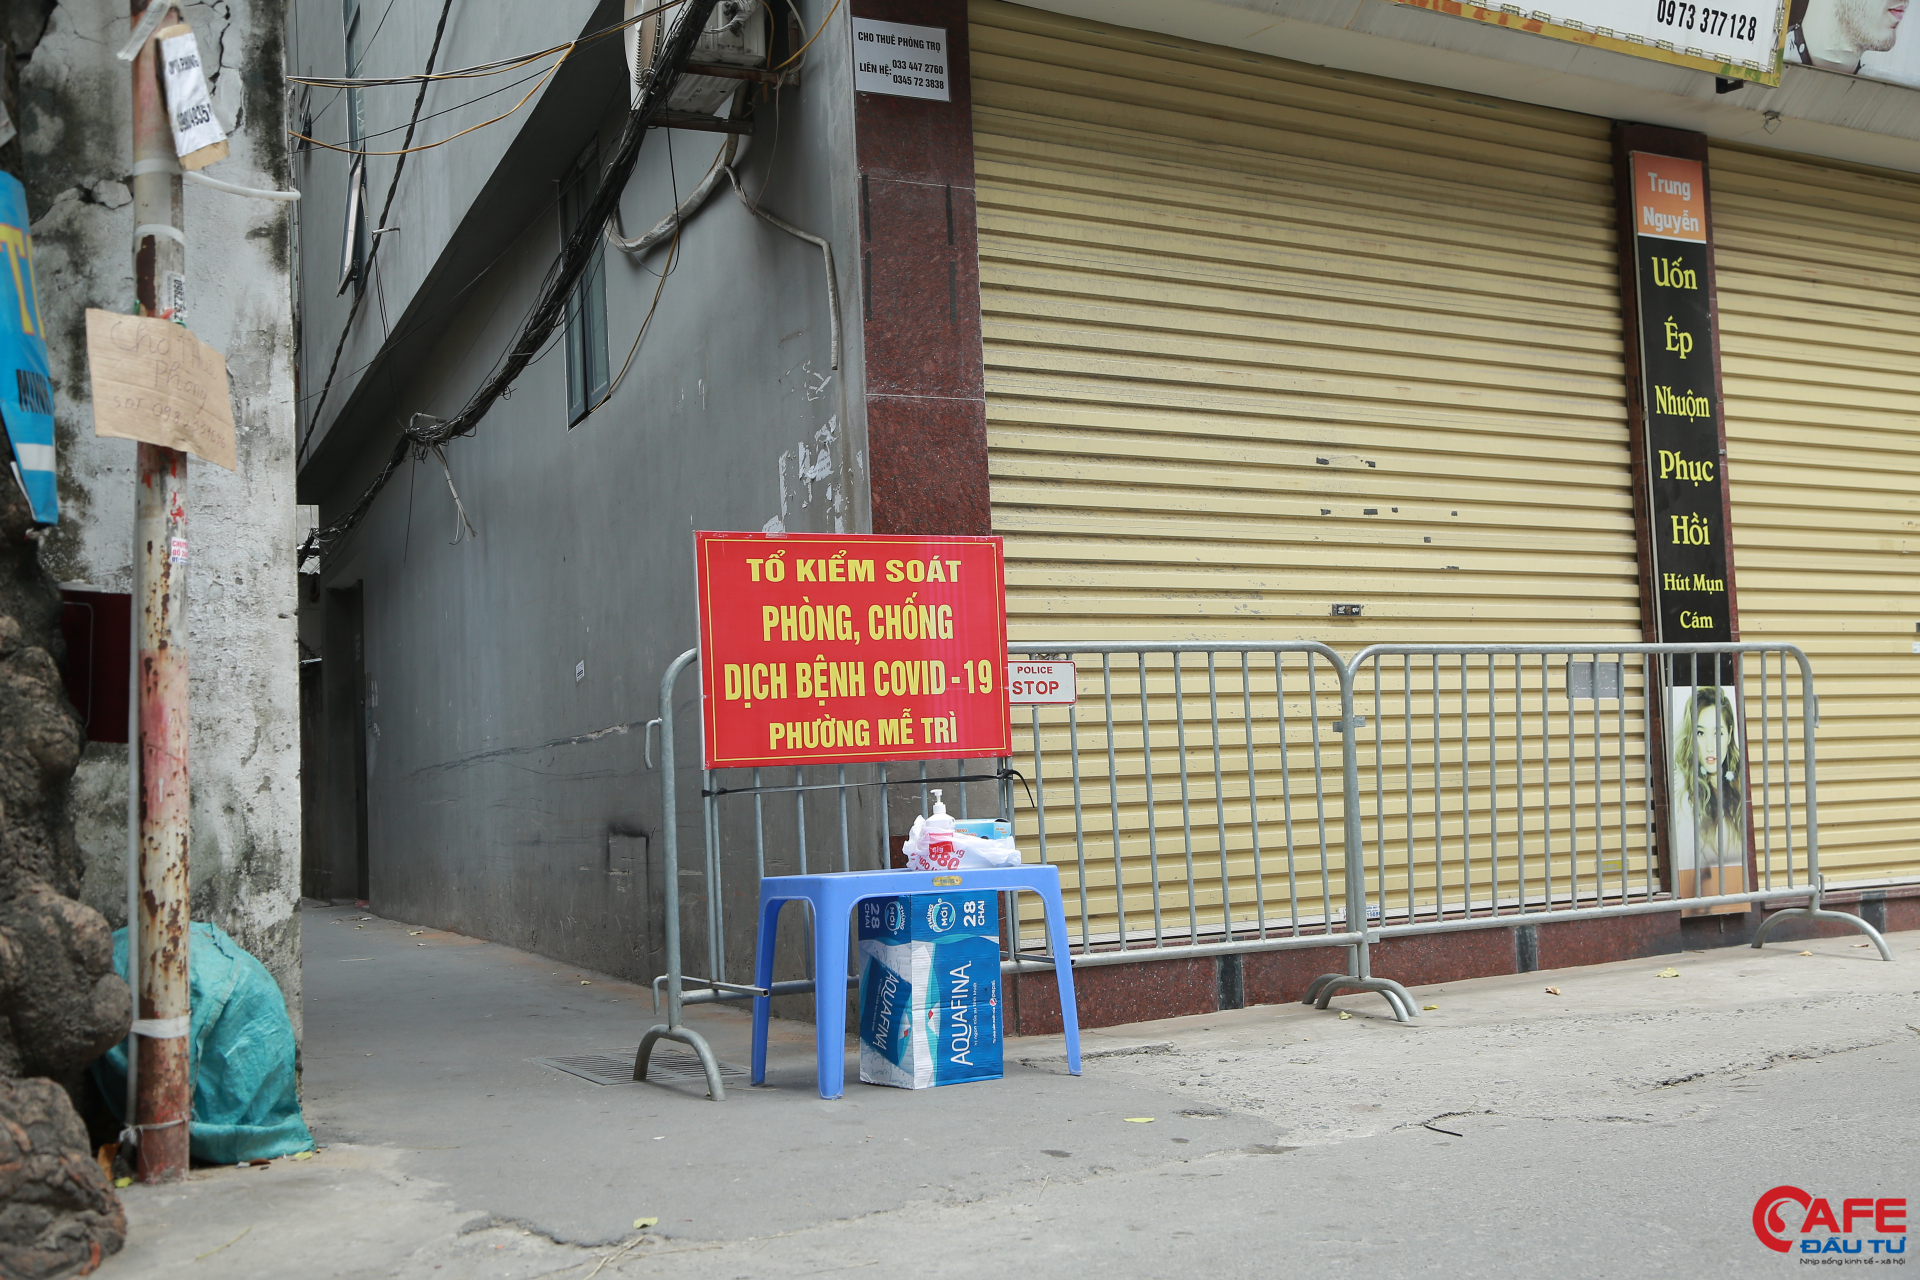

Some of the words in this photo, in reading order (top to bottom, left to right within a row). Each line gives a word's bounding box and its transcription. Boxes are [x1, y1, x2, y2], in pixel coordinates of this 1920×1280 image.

[1657, 0, 1696, 30] 0973
[1700, 7, 1757, 42] 377128
[858, 31, 874, 42] CHO
[876, 34, 896, 46] THUÊ
[898, 36, 924, 49] PHÒNG
[926, 40, 941, 53] TRỌ
[859, 62, 877, 73] LIÊN
[879, 64, 892, 76] HỆ:
[892, 59, 907, 70] 033
[908, 61, 923, 72] 447
[924, 63, 944, 74] 2760
[893, 74, 912, 86] 0345
[914, 77, 924, 87] 72
[925, 79, 944, 90] 3838
[1648, 172, 1691, 202] Trung
[1643, 206, 1699, 235] Nguyễn
[1651, 256, 1698, 290] Uốn
[110, 321, 170, 356] Cho
[1664, 316, 1694, 359] Ép
[1654, 385, 1711, 423] Nhuộm
[1658, 450, 1714, 487] Phục
[1670, 512, 1711, 546] Hồi
[746, 549, 786, 583] TỔ
[796, 549, 875, 583] KIỂM
[885, 555, 962, 583] SOÁT
[1662, 573, 1691, 592] Hút
[1692, 573, 1725, 595] Mụn
[762, 596, 861, 645] PHÒNG,
[868, 592, 954, 641] CHỐNG
[1680, 610, 1714, 629] Cám
[724, 662, 788, 709] DỊCH
[795, 654, 866, 707] BỆNH
[873, 660, 946, 696] COVID
[1017, 666, 1054, 675] POLICE
[1012, 680, 1060, 695] STOP
[769, 714, 871, 750] PHƯỜNG
[877, 708, 915, 746] MỄ
[920, 710, 958, 744] TRÌ
[869, 903, 880, 929] 28
[888, 906, 896, 927] MỚI
[926, 903, 935, 930] THÙNG
[940, 906, 949, 926] MỚI
[963, 900, 977, 927] 28
[872, 969, 900, 1051] AQUAFINA
[949, 961, 974, 1066] AQUAFINA
